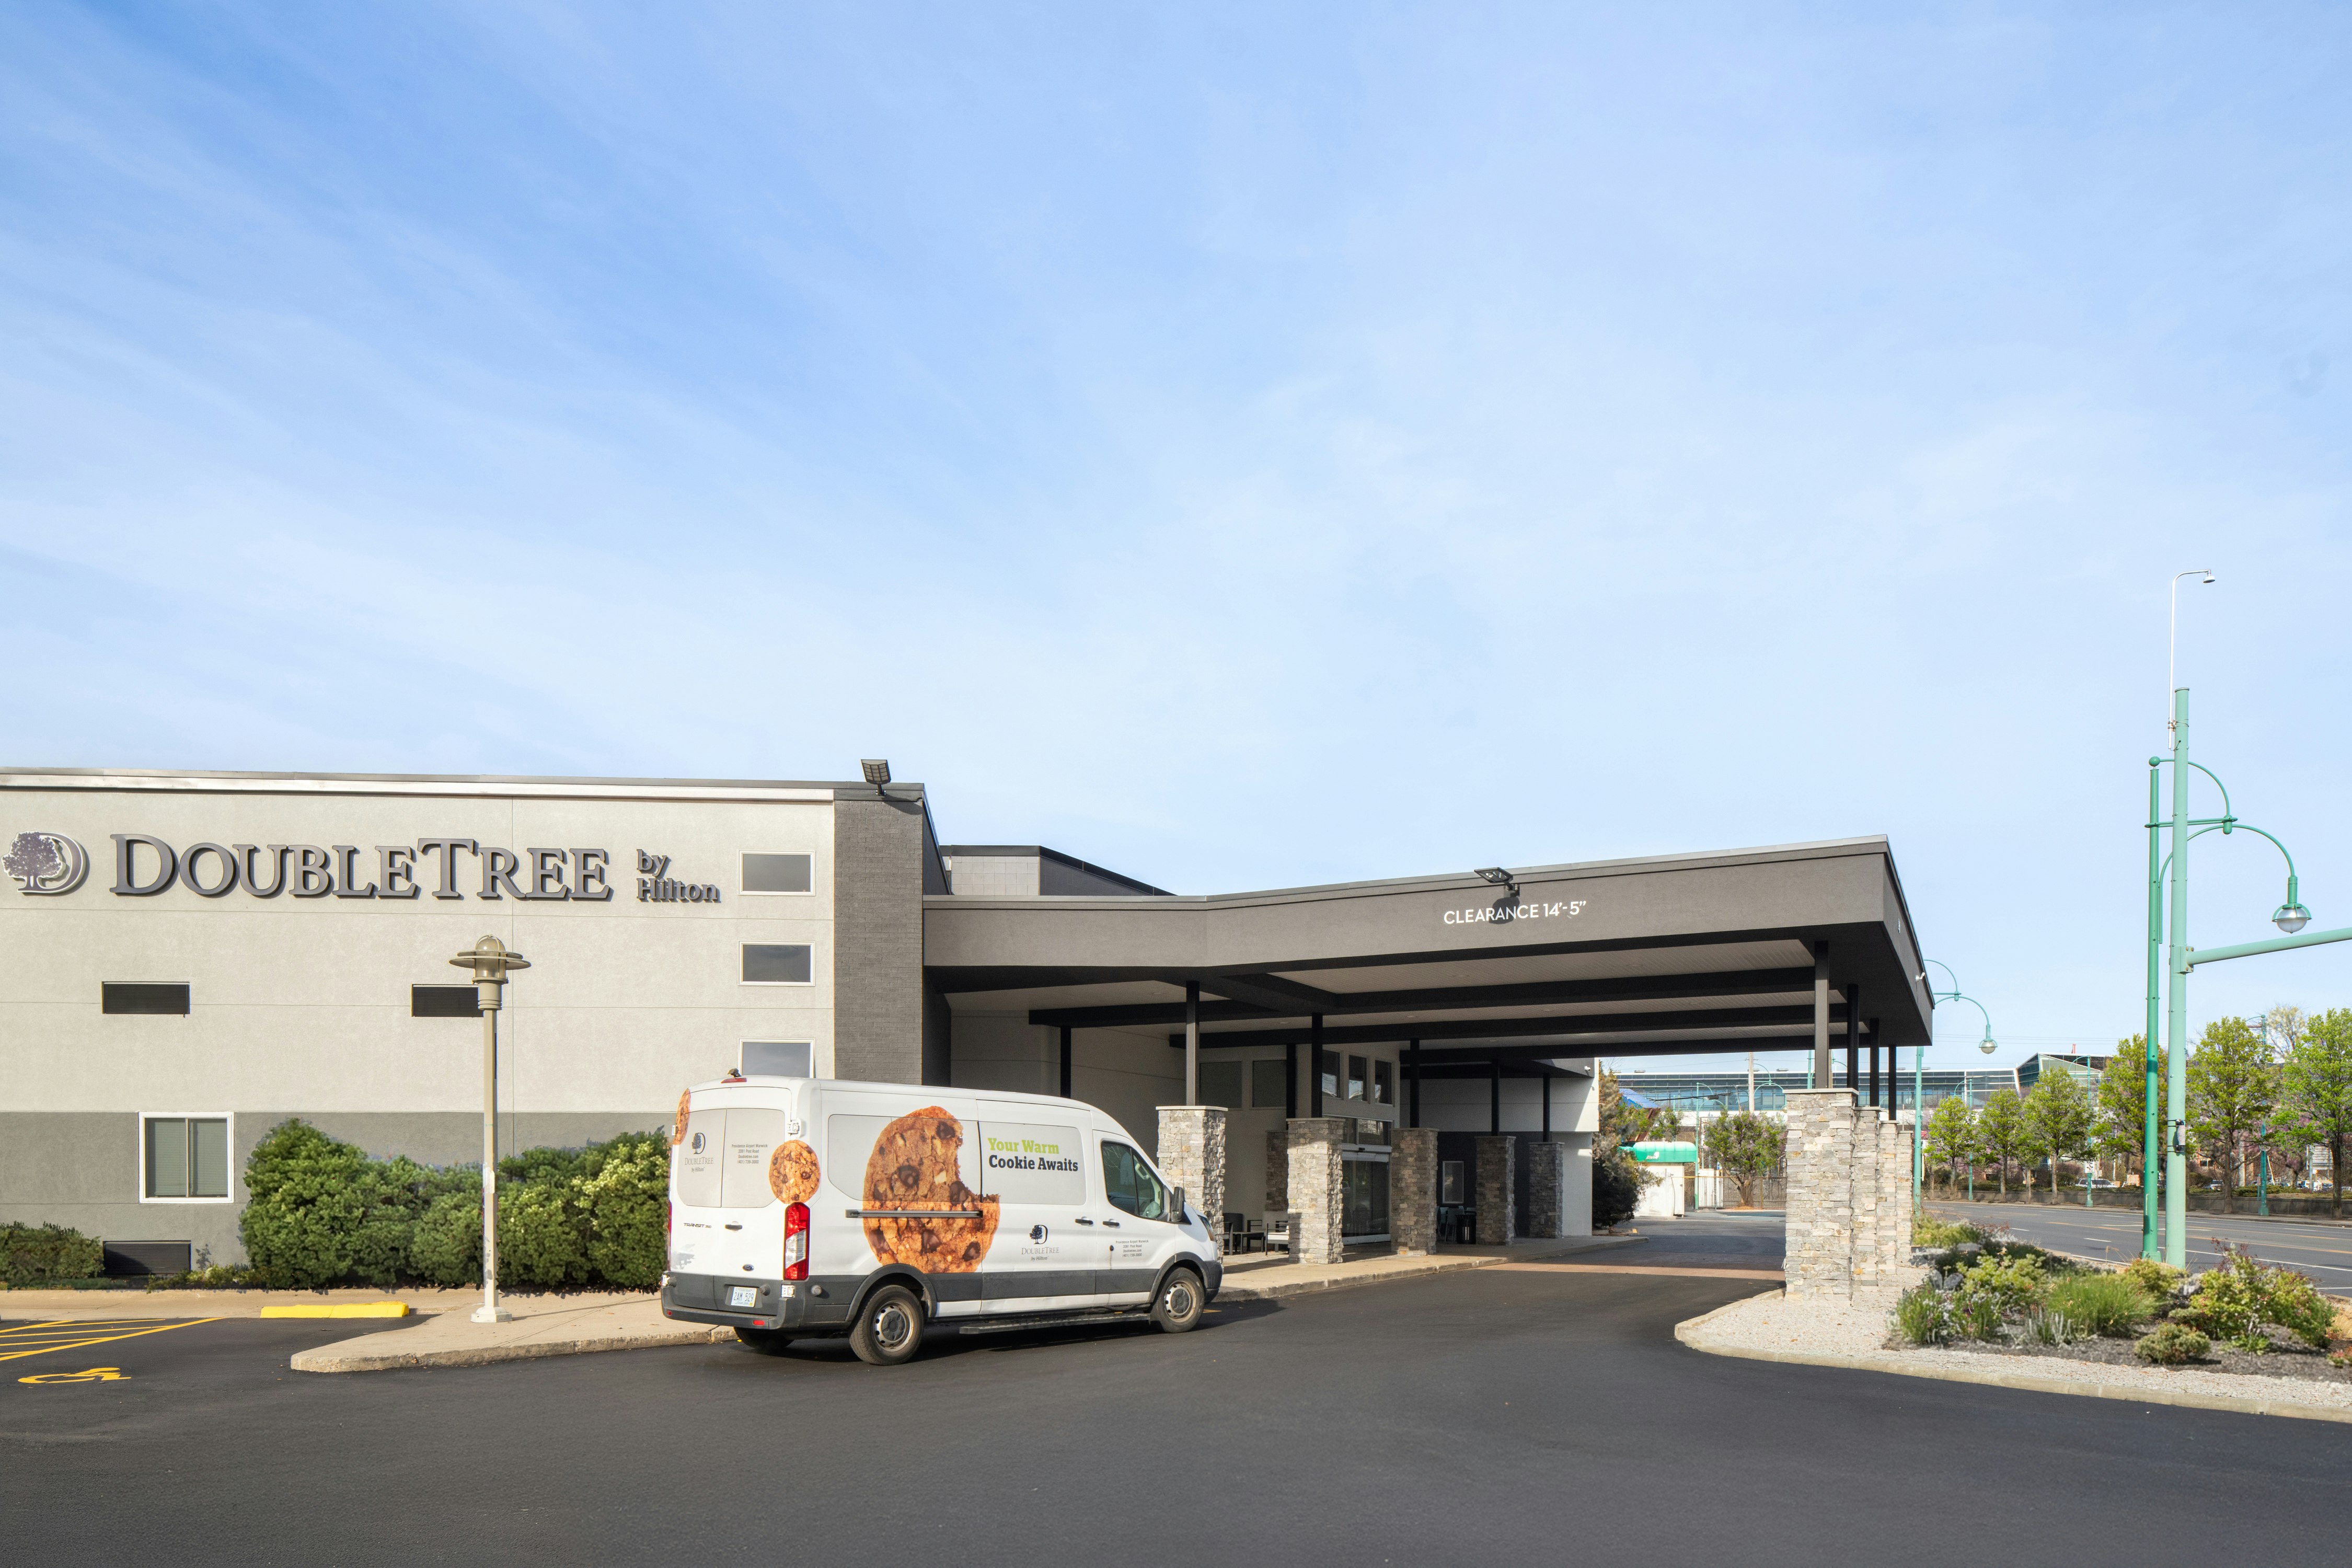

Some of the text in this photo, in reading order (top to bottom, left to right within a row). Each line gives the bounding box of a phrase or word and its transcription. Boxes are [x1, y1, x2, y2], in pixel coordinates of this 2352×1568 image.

[637, 849, 669, 879] by
[637, 878, 719, 902] Hilton
[1444, 904, 1539, 924] CLEARANCE
[987, 1137, 1059, 1154] Your Warm
[989, 1155, 1078, 1171] Cookie Awaits
[745, 1293, 754, 1301] 529
